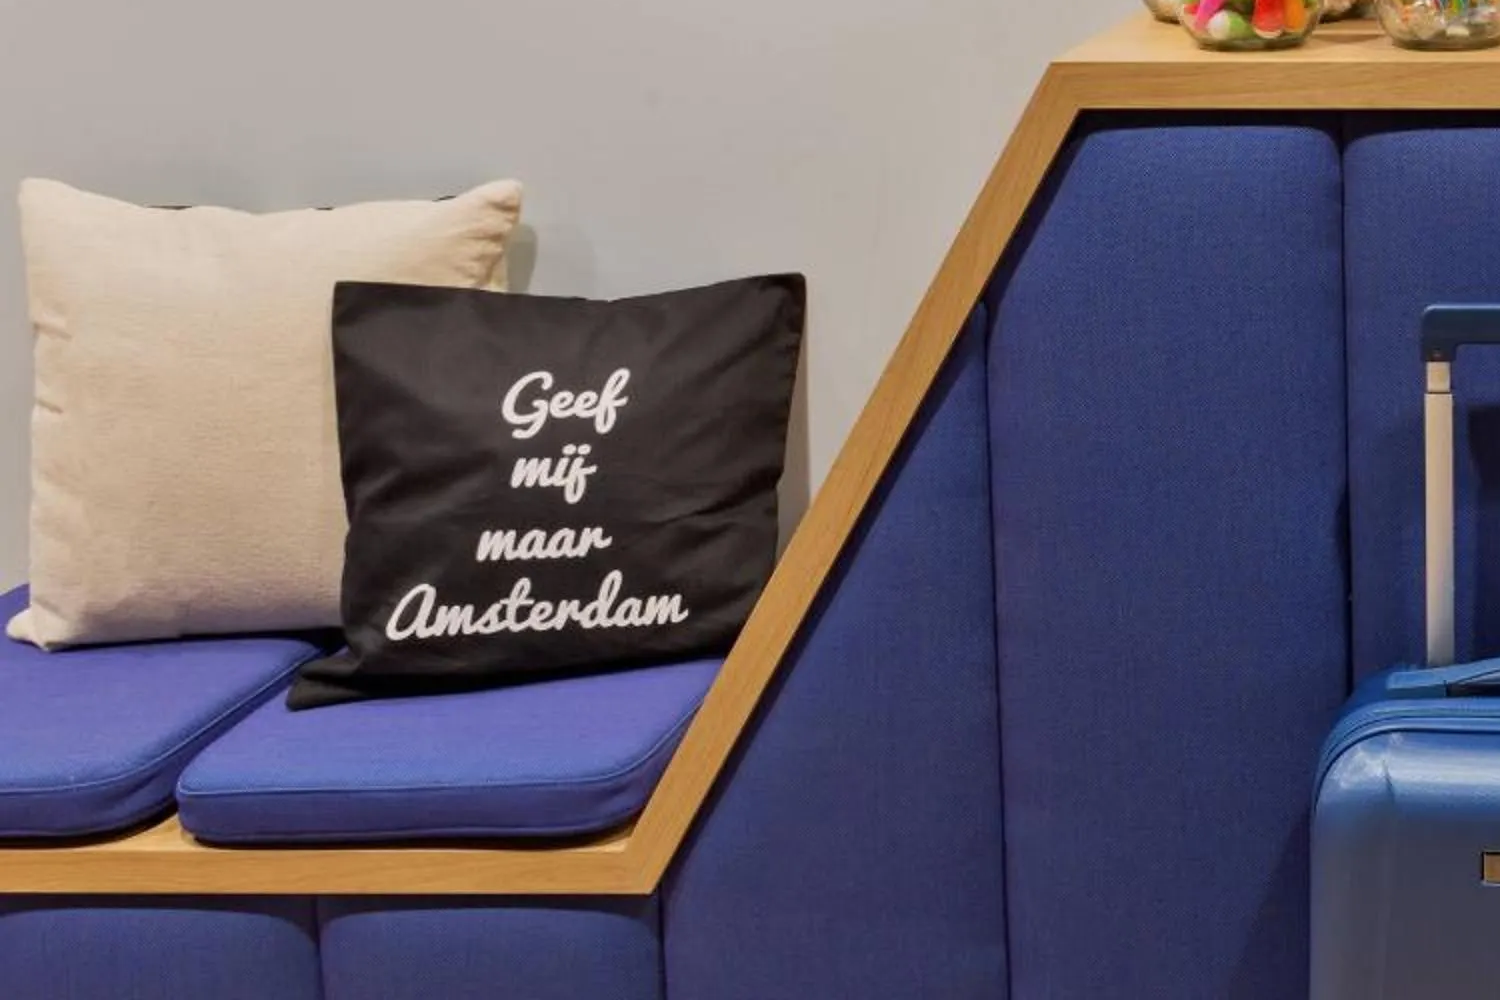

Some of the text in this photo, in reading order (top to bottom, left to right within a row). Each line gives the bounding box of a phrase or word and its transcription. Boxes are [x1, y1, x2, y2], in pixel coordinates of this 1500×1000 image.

[502, 368, 631, 439] Geef
[510, 444, 597, 504] mij
[476, 526, 612, 562] maar
[385, 570, 689, 640] Amsterdam
